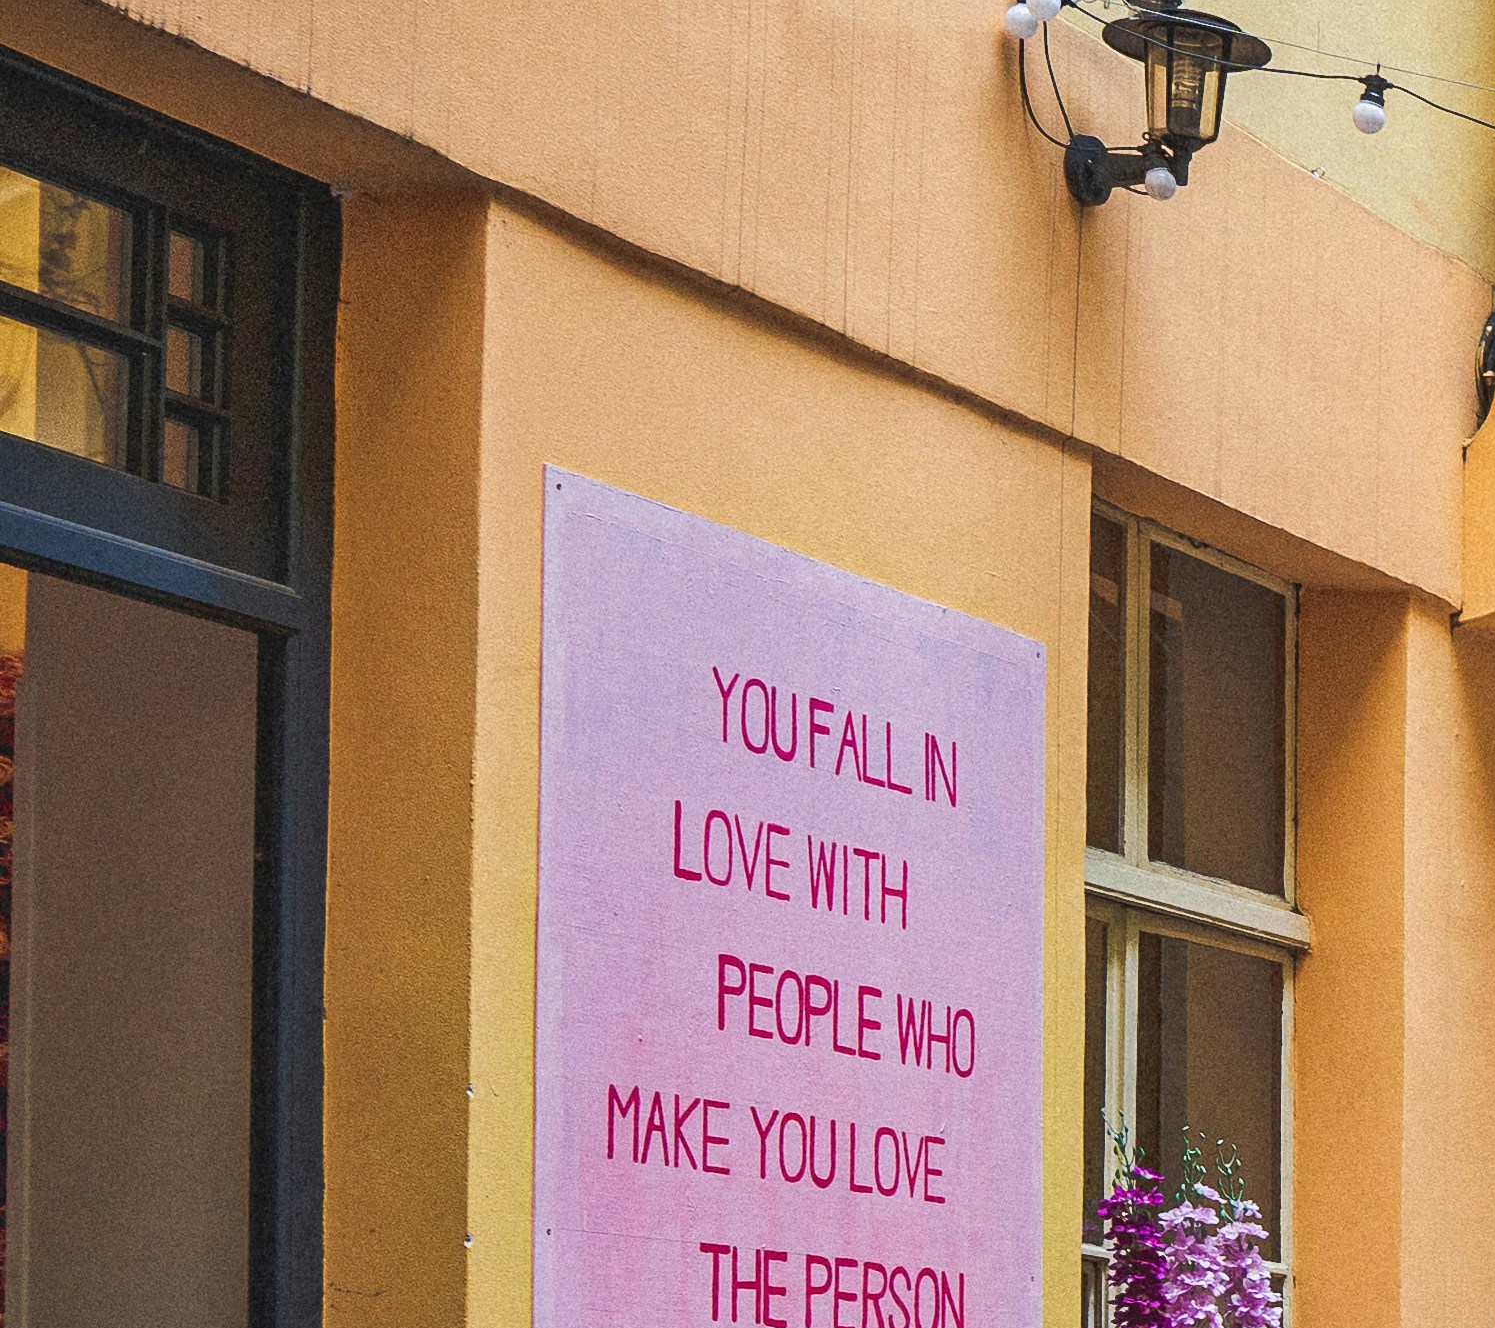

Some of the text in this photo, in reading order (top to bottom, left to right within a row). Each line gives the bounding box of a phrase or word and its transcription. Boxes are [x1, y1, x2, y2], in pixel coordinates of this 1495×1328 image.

[712, 666, 957, 808] YOU FALL IN
[673, 799, 908, 930] LOVE WITH
[717, 953, 975, 1078] PEOPLE WHO
[607, 1083, 946, 1204] MAKE YOU LOVE
